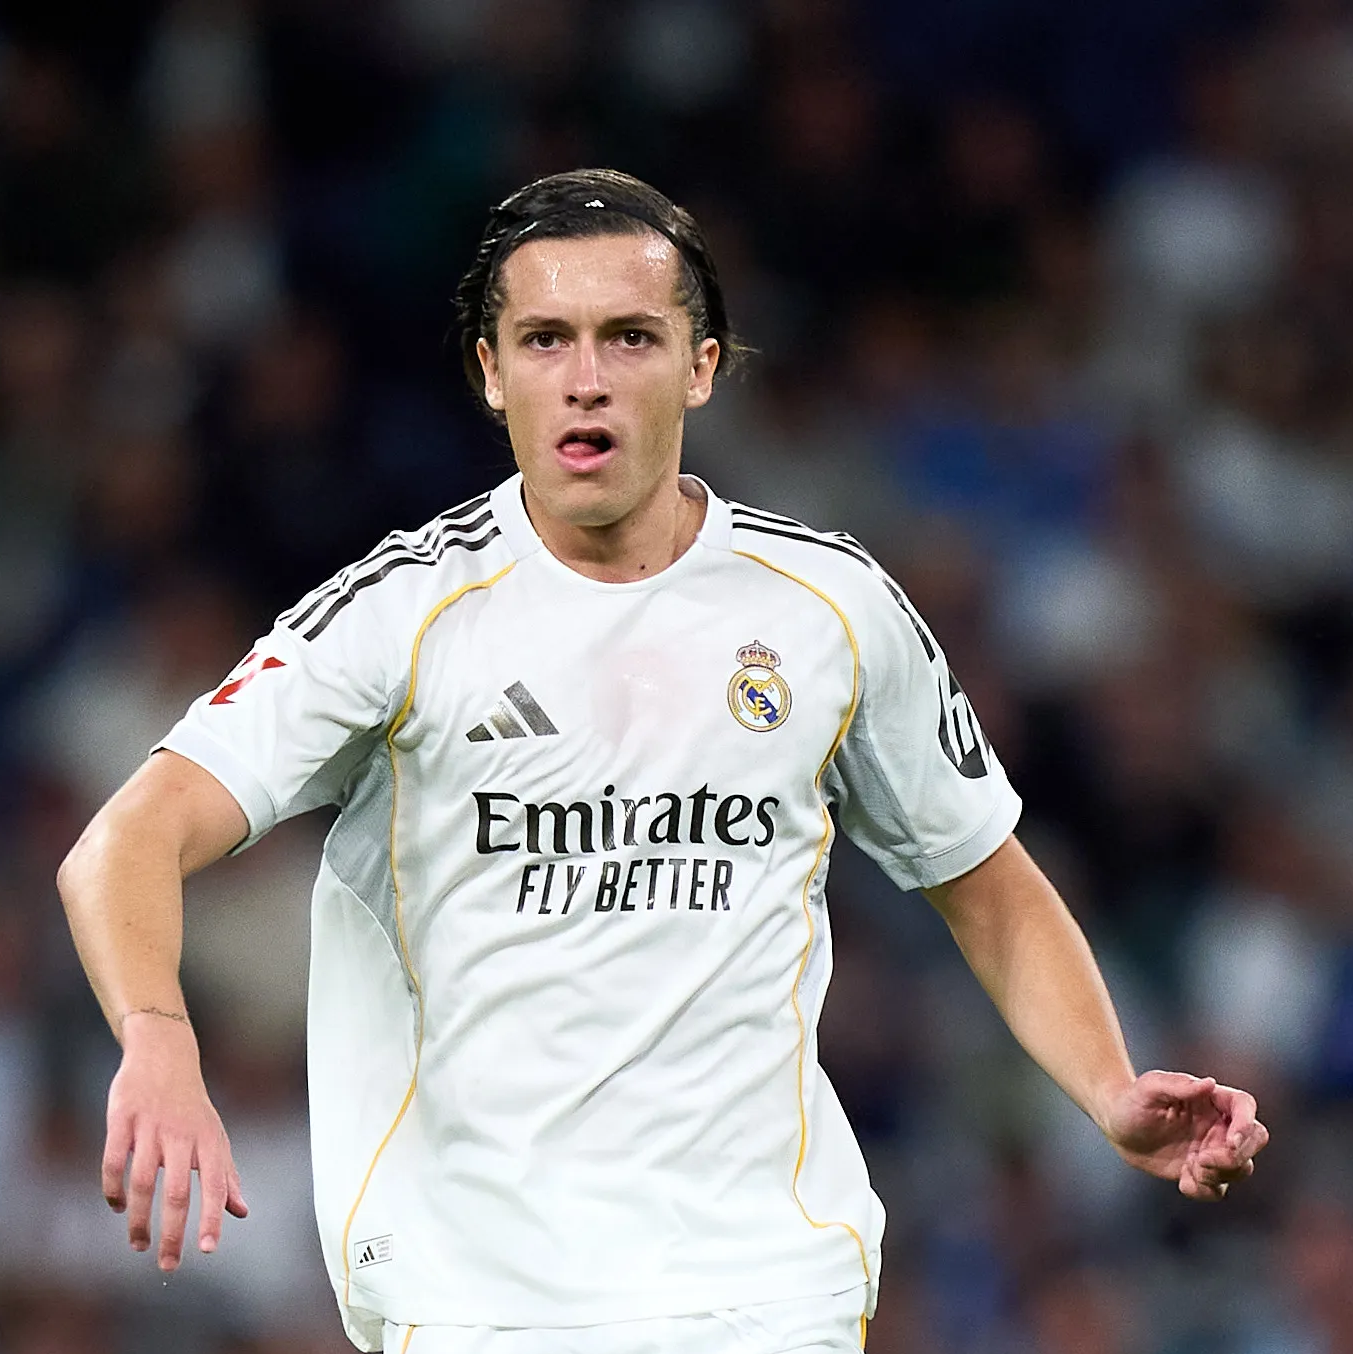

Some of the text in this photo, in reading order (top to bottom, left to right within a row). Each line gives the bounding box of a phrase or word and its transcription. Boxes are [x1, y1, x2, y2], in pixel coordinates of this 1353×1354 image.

[471, 782, 780, 855] Emirates
[515, 857, 734, 915] FLY BETTER
